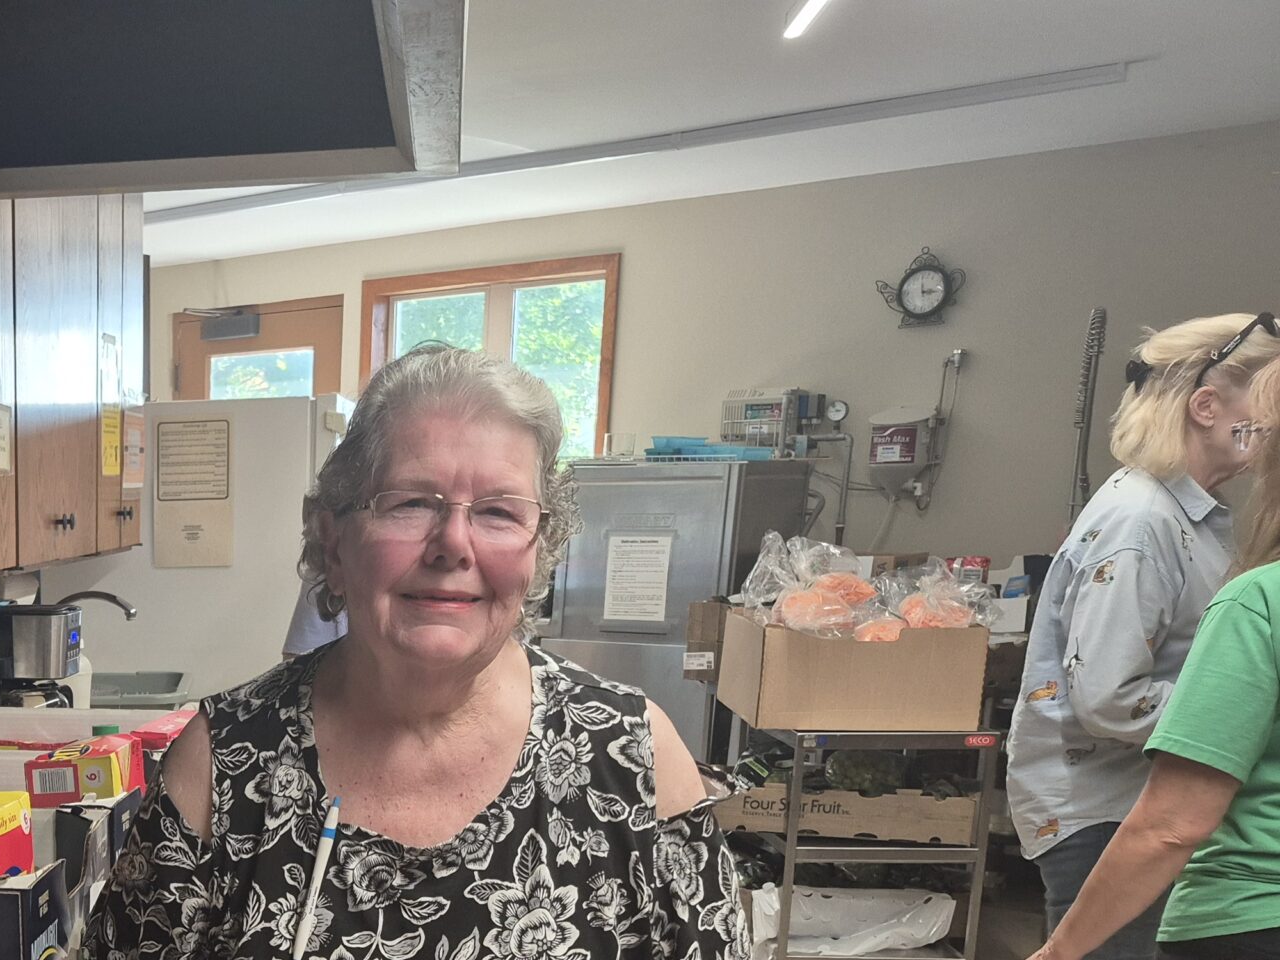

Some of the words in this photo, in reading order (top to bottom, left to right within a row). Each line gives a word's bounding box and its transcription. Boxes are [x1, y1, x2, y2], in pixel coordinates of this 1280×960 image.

[742, 796, 776, 810] Four
[778, 798, 810, 812] Sr
[810, 800, 842, 814] Fruit
